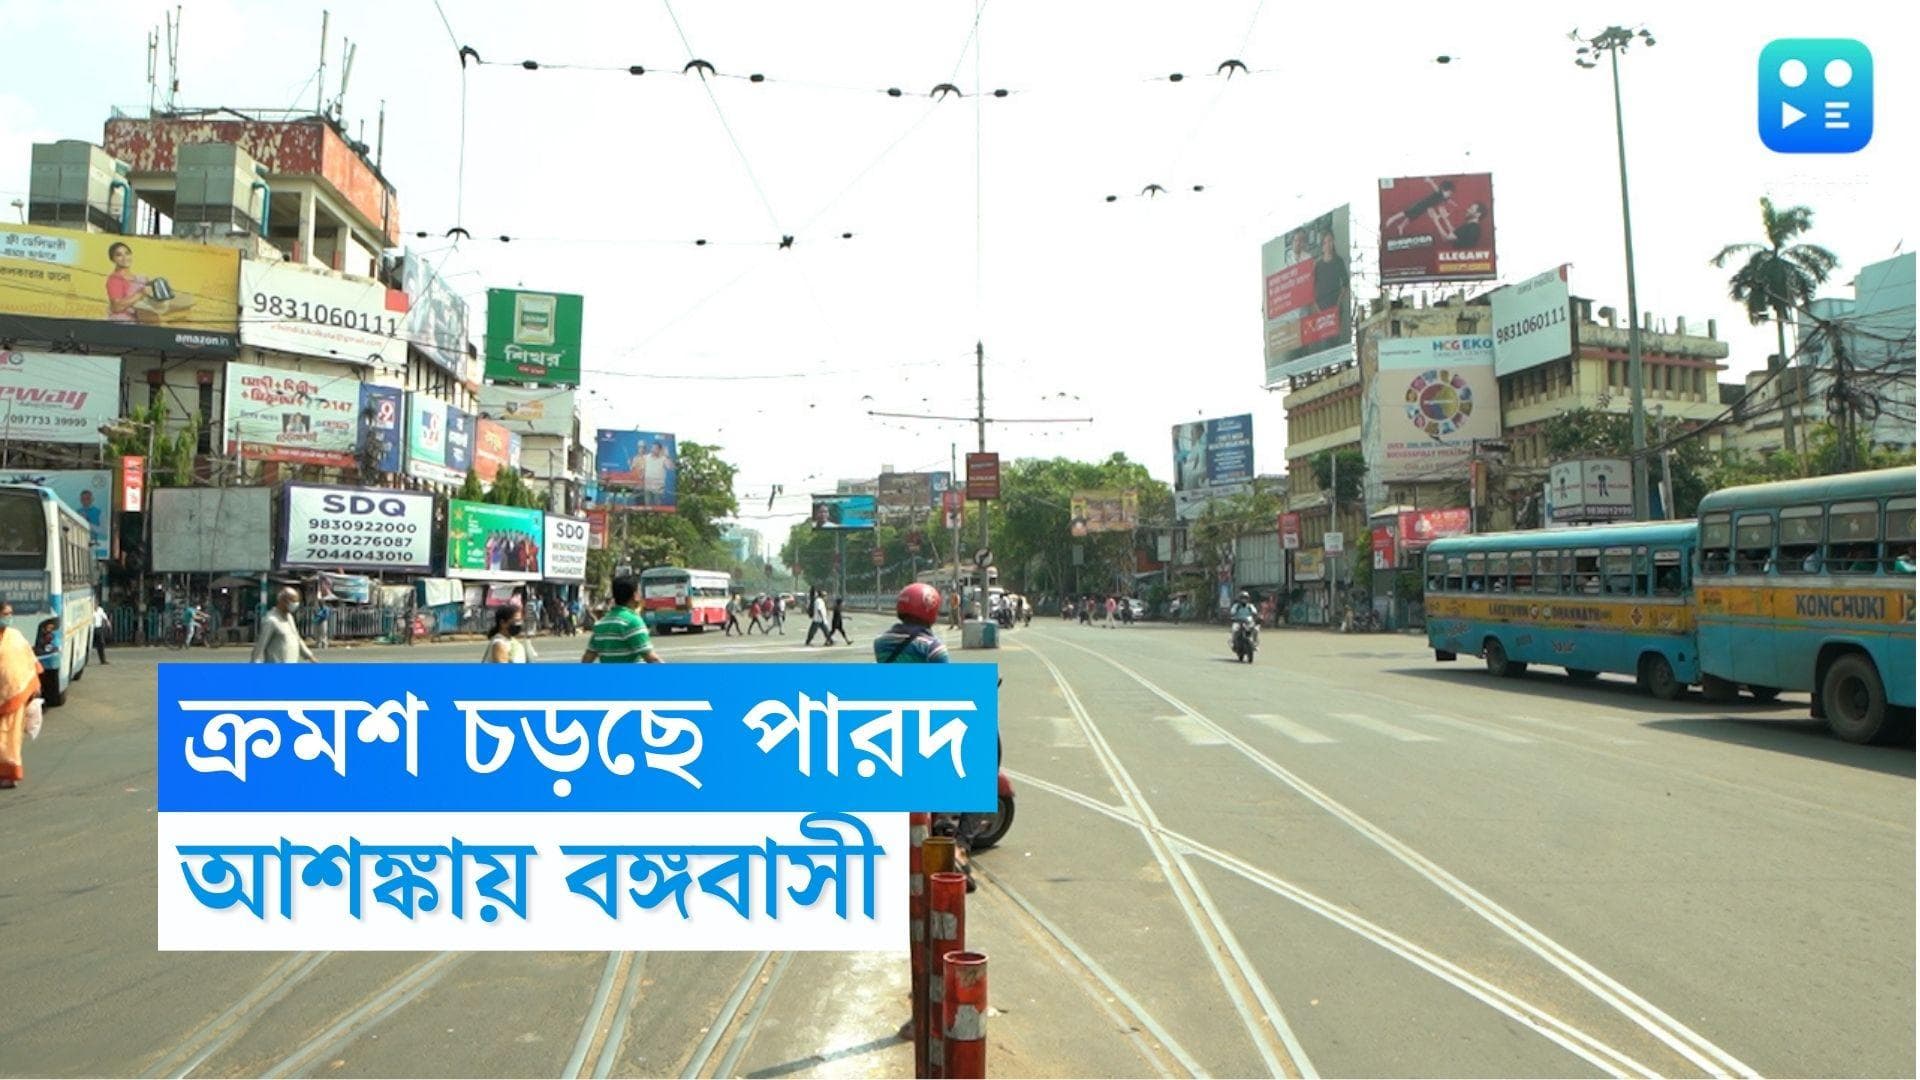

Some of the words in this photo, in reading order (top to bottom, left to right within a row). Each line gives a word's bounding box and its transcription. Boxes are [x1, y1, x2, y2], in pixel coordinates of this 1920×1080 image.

[253, 292, 397, 338] 9831060111
[1496, 305, 1566, 346] 9831060111
[174, 333, 229, 346] amazon.in
[1433, 340, 1461, 351] HCG
[1462, 338, 1493, 349] EKO
[504, 344, 562, 367] শিখর
[323, 494, 406, 517] SDQ
[309, 519, 417, 534] 9830922000
[556, 523, 585, 540] SDQ
[308, 534, 412, 548] 9830276087
[306, 549, 413, 562] 7044043010
[1795, 594, 1885, 619] KONCHUKI
